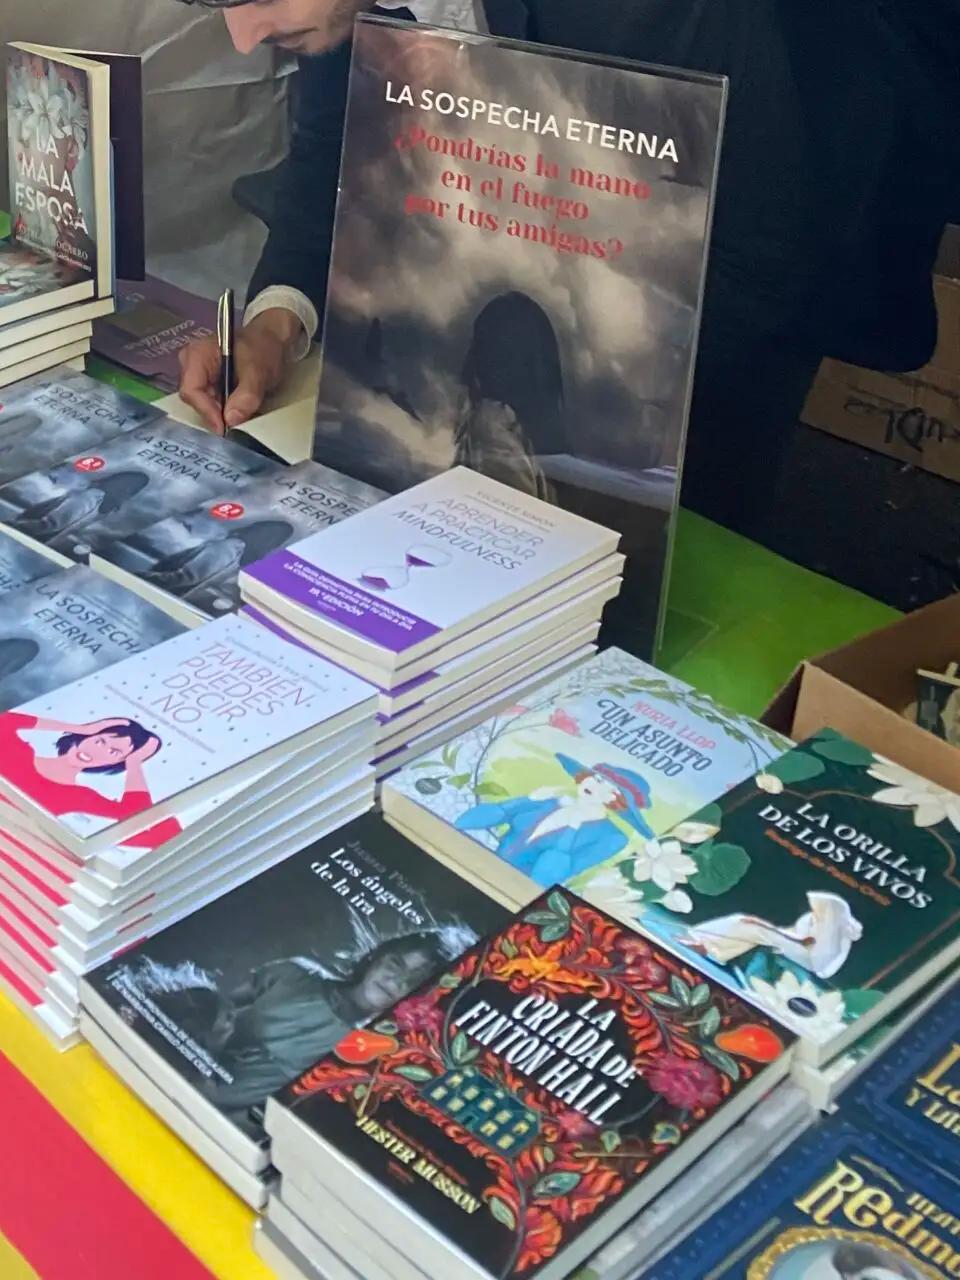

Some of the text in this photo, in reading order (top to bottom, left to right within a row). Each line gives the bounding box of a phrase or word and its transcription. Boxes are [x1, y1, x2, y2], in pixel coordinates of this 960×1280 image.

[35, 126, 59, 159] LA
[385, 80, 680, 163] LA SOSPECHA ETERNA
[20, 151, 75, 197] MALA
[441, 170, 590, 220] en el fuego
[535, 152, 560, 180] la
[569, 167, 652, 201] mano
[14, 182, 89, 235] ESPOSA
[457, 202, 498, 232] tus
[136, 448, 201, 481] ETERNA
[153, 439, 241, 483] SOSPECHA
[274, 477, 297, 490] LA
[296, 486, 360, 518] SOSPE
[279, 495, 342, 526] ETERN
[436, 497, 545, 549] APRENDER
[391, 509, 523, 571] MINDFULNESS
[428, 508, 538, 561] PRACTICAR
[33, 607, 104, 655] ETERNA
[35, 583, 60, 601] LA
[55, 595, 146, 655] SOSPECH
[150, 694, 202, 724] NO
[161, 672, 247, 723] DECIR
[177, 655, 285, 716] PUEDES
[589, 719, 685, 778] DELICADO
[596, 698, 714, 772] UN ASUNTO
[757, 803, 800, 833] DE
[795, 826, 851, 864] LOS
[851, 854, 934, 910] VIVOS
[796, 801, 831, 829] LA
[832, 823, 928, 883] ORILLA
[310, 861, 376, 916] de la ira
[329, 847, 363, 878] Los
[360, 875, 425, 926] ángeles
[511, 992, 644, 1089] CRIADA DE
[576, 998, 618, 1032] LA
[454, 999, 622, 1126] FINTON HALL
[355, 1114, 417, 1164] HESTER
[412, 1158, 482, 1215] MUSSON
